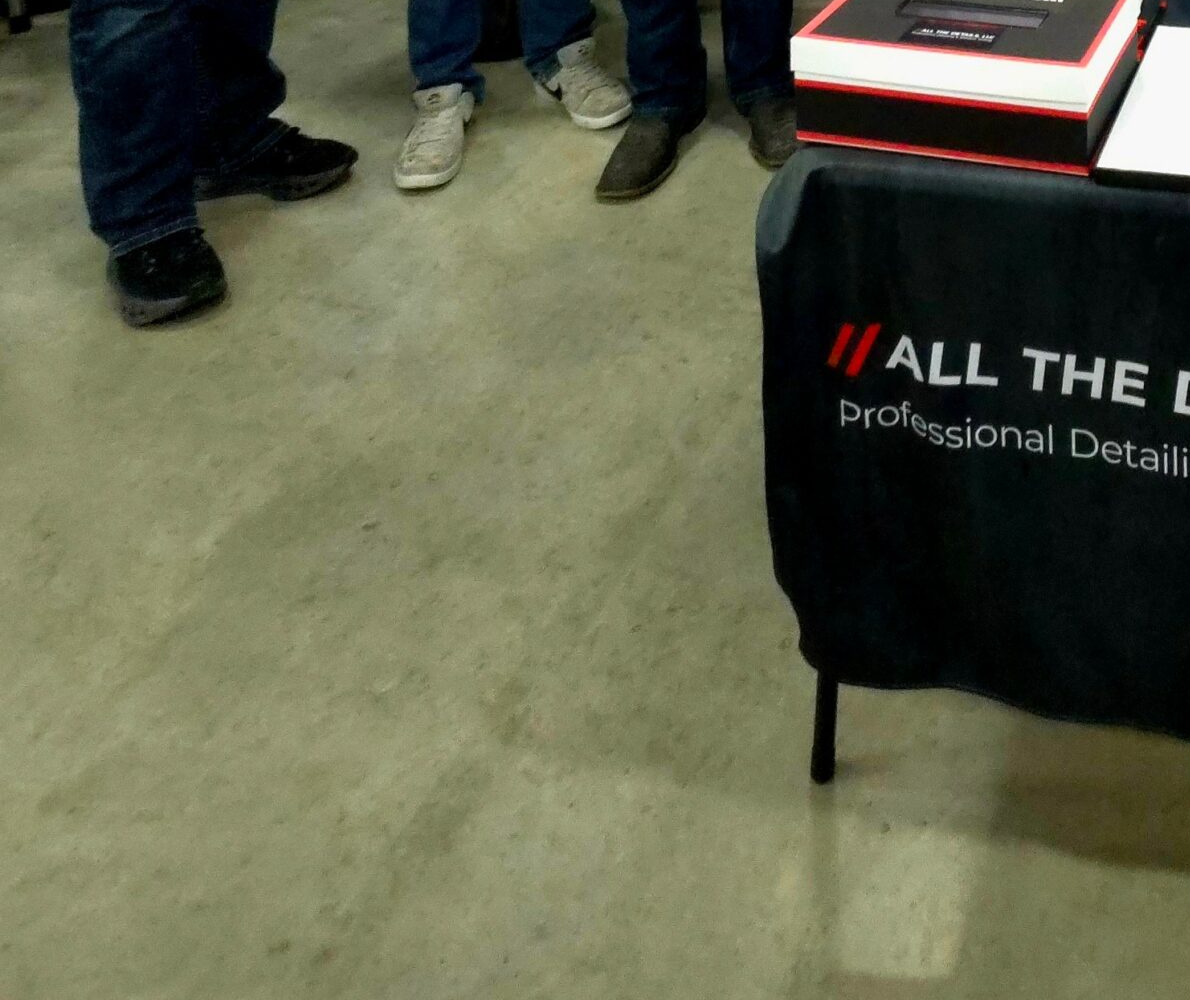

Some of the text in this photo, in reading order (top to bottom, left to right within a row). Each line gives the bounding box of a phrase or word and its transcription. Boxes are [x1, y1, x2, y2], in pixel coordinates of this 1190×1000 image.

[885, 334, 1000, 387] ALL
[1023, 347, 1150, 408] THE
[839, 399, 1055, 455] Professional
